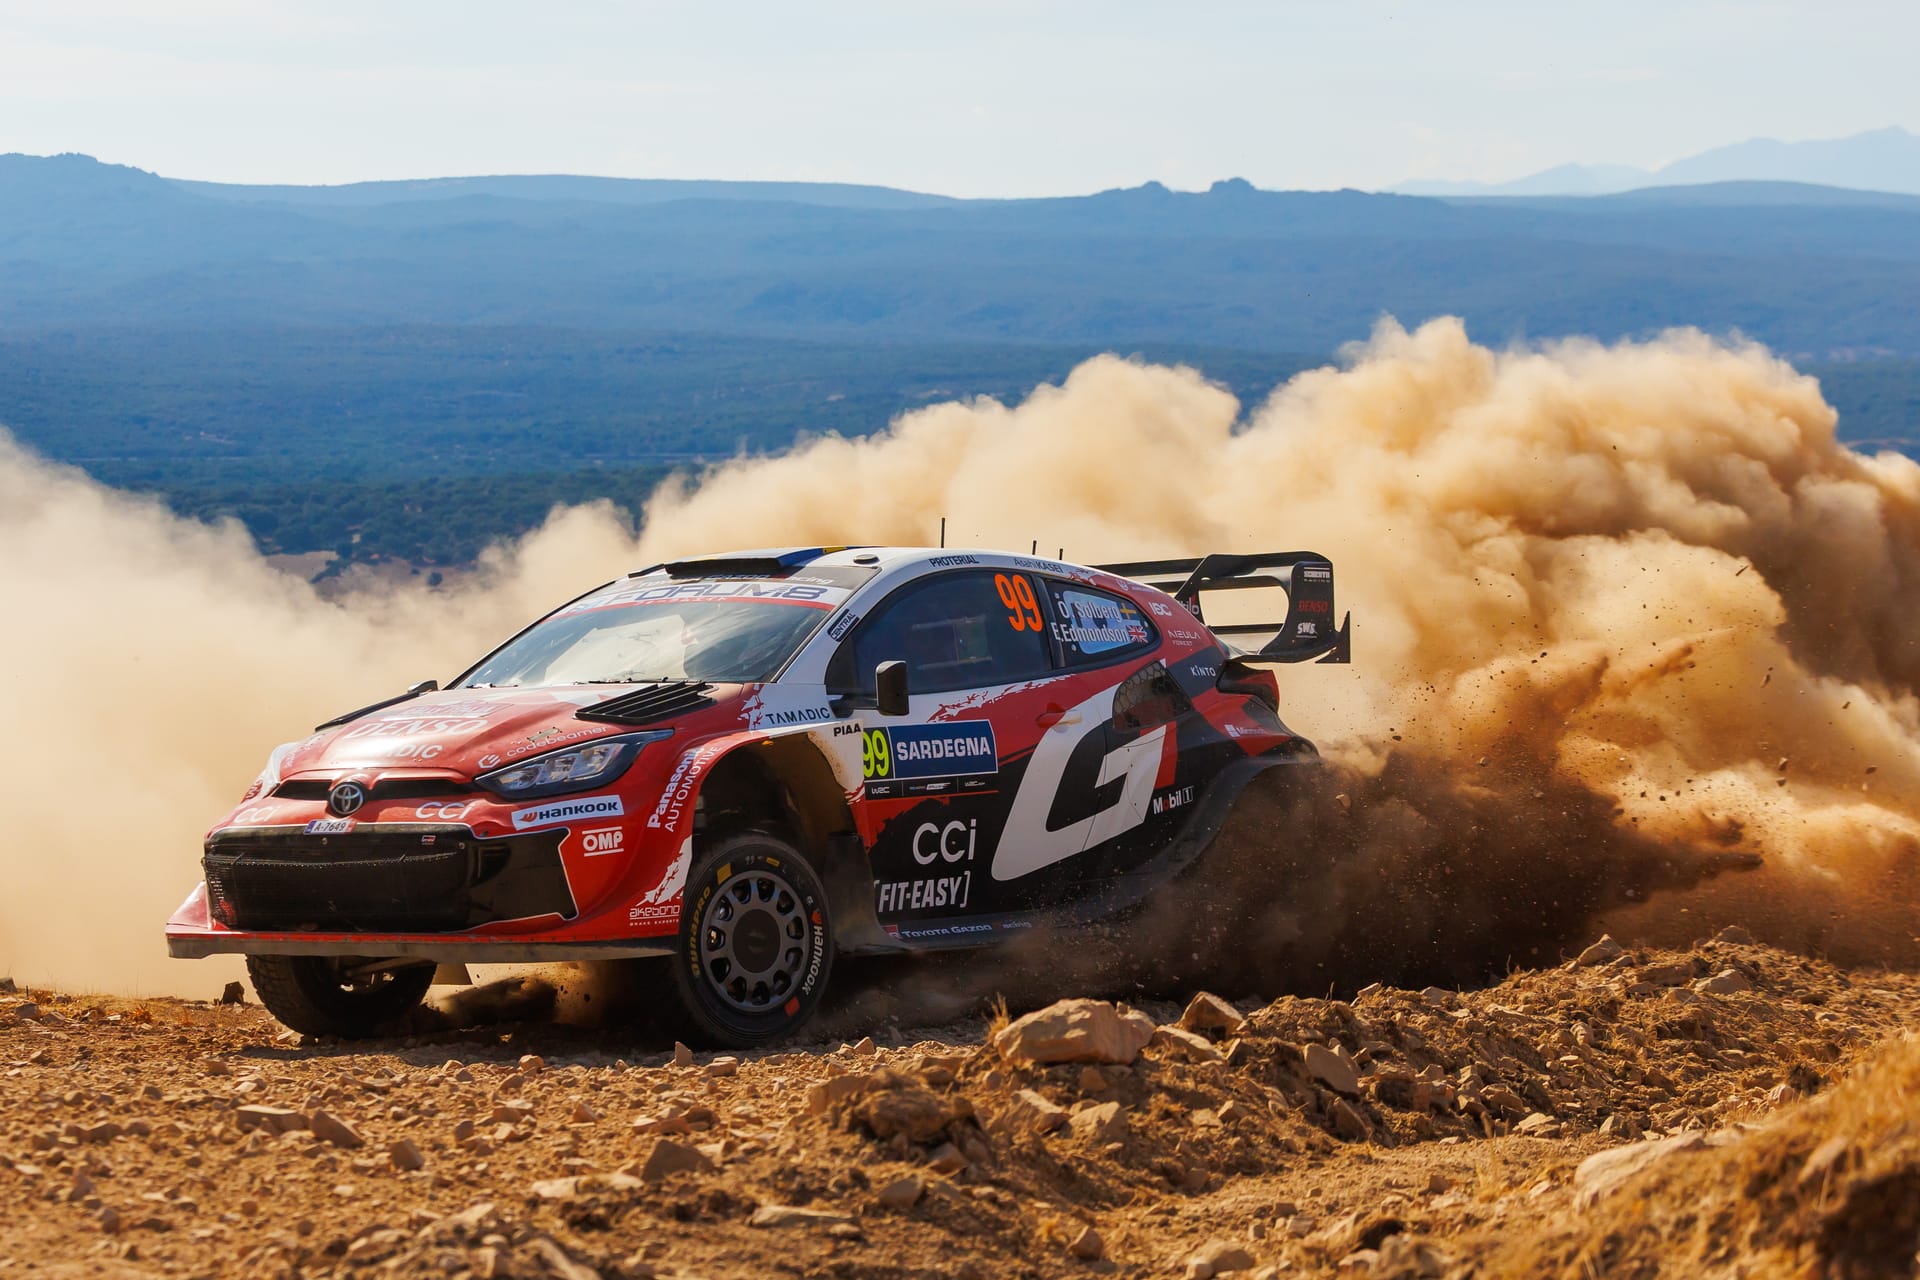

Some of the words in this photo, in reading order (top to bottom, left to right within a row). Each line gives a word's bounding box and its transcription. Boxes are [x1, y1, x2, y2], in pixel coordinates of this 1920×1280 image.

[929, 555, 980, 567] PROTERIAL
[994, 573, 1043, 632] 99
[1074, 600, 1122, 623] Solberg
[1297, 600, 1329, 613] DENSO
[831, 612, 857, 639] CENTRAL
[765, 706, 831, 727] TAMADIC
[344, 720, 487, 739] DENSO
[833, 723, 861, 737] PIAA
[506, 726, 608, 757] codebeamer
[897, 736, 992, 761] SARDEGNA
[665, 746, 722, 833] AUTOMOTIVE
[1153, 790, 1182, 815] Mobil
[313, 822, 347, 832] A-7649
[583, 830, 624, 853] OMP
[629, 905, 681, 918] akebono
[901, 929, 951, 939] TOYOTA
[951, 924, 993, 934] GAZOO
